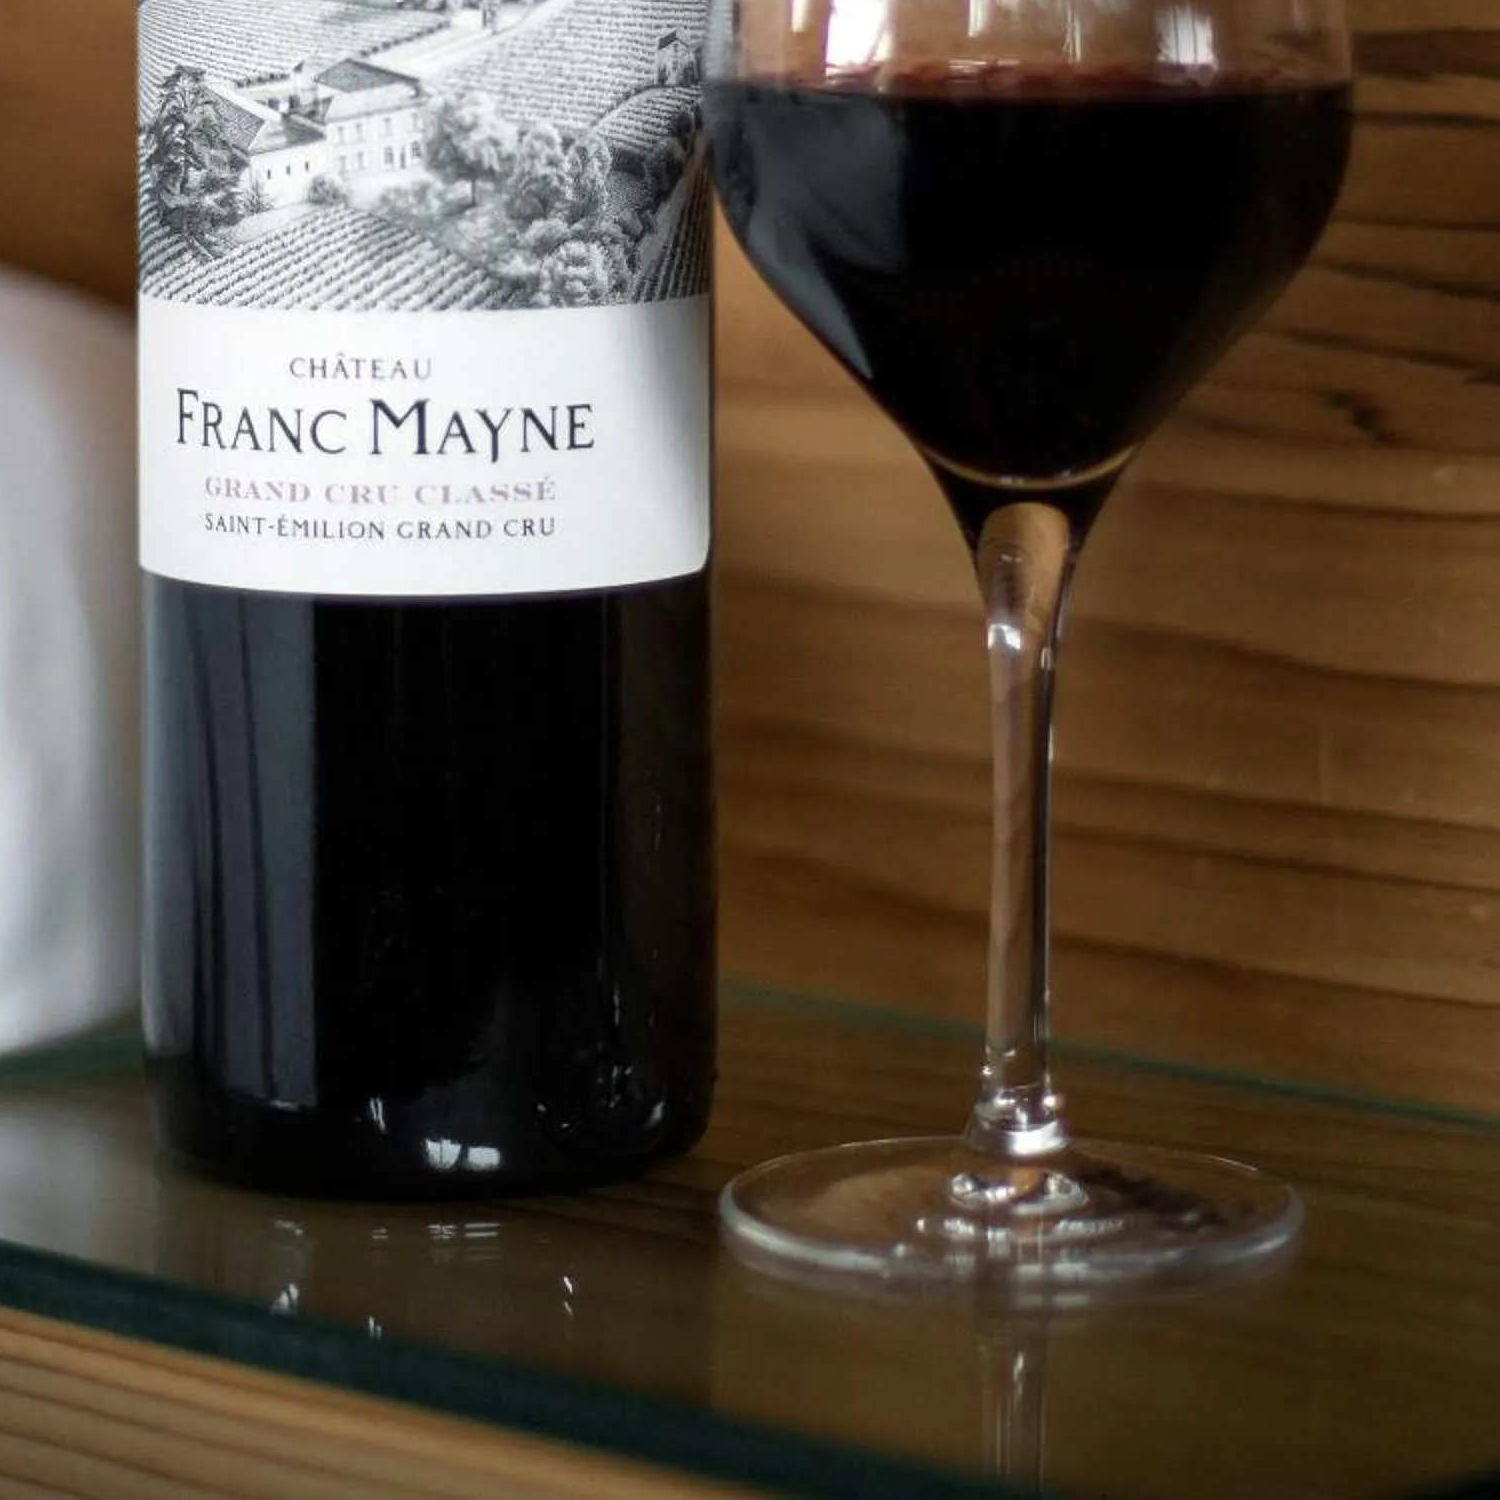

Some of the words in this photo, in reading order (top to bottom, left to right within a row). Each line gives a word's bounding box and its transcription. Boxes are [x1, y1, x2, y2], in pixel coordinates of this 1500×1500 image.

[288, 352, 432, 380] CHÂTEAU
[177, 388, 347, 454] FRANC
[369, 398, 595, 463] MAYNE
[204, 475, 311, 504] GRAND
[324, 484, 400, 505] CRU
[414, 476, 556, 505] CLASSÉ
[204, 512, 385, 540] SAINT-ÉMILION
[396, 519, 492, 539] GRAND
[503, 518, 556, 538] CRU
